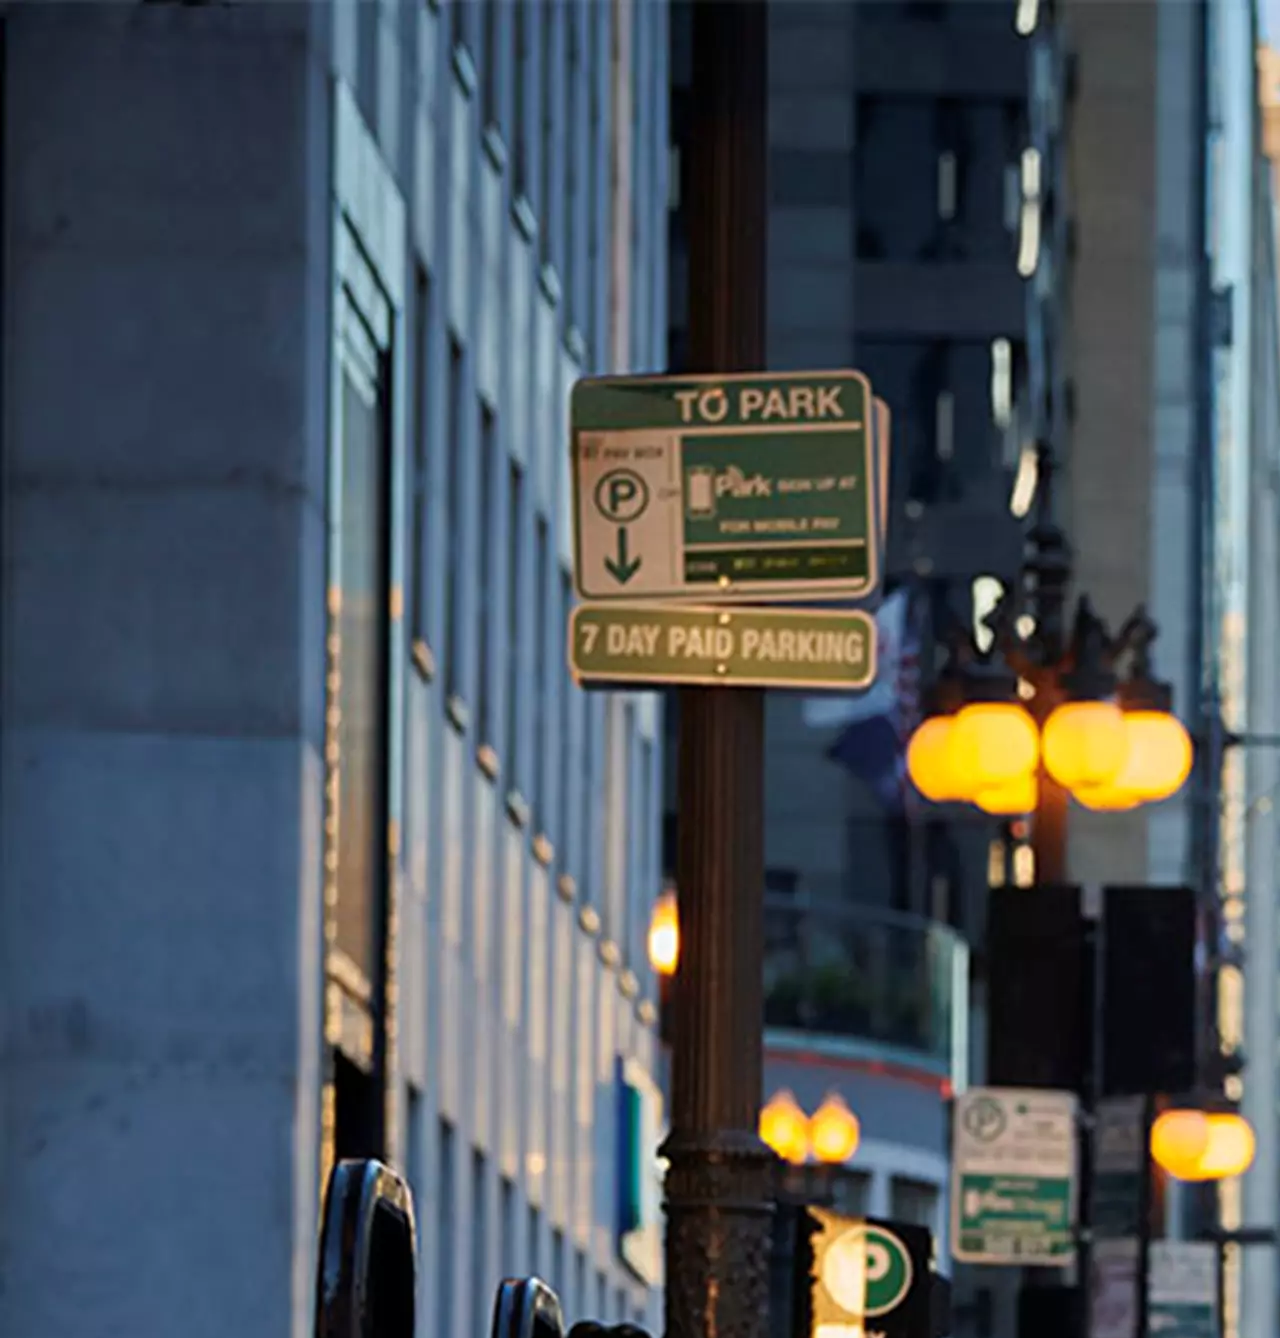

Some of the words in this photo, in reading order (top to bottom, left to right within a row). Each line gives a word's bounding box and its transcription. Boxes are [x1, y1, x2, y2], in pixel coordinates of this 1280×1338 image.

[674, 388, 729, 422] TO
[740, 386, 844, 419] PARK
[608, 478, 637, 513] P
[580, 624, 599, 655] 7
[606, 623, 661, 656] DAY
[667, 624, 733, 659] PAID
[740, 627, 864, 664] PARKING
